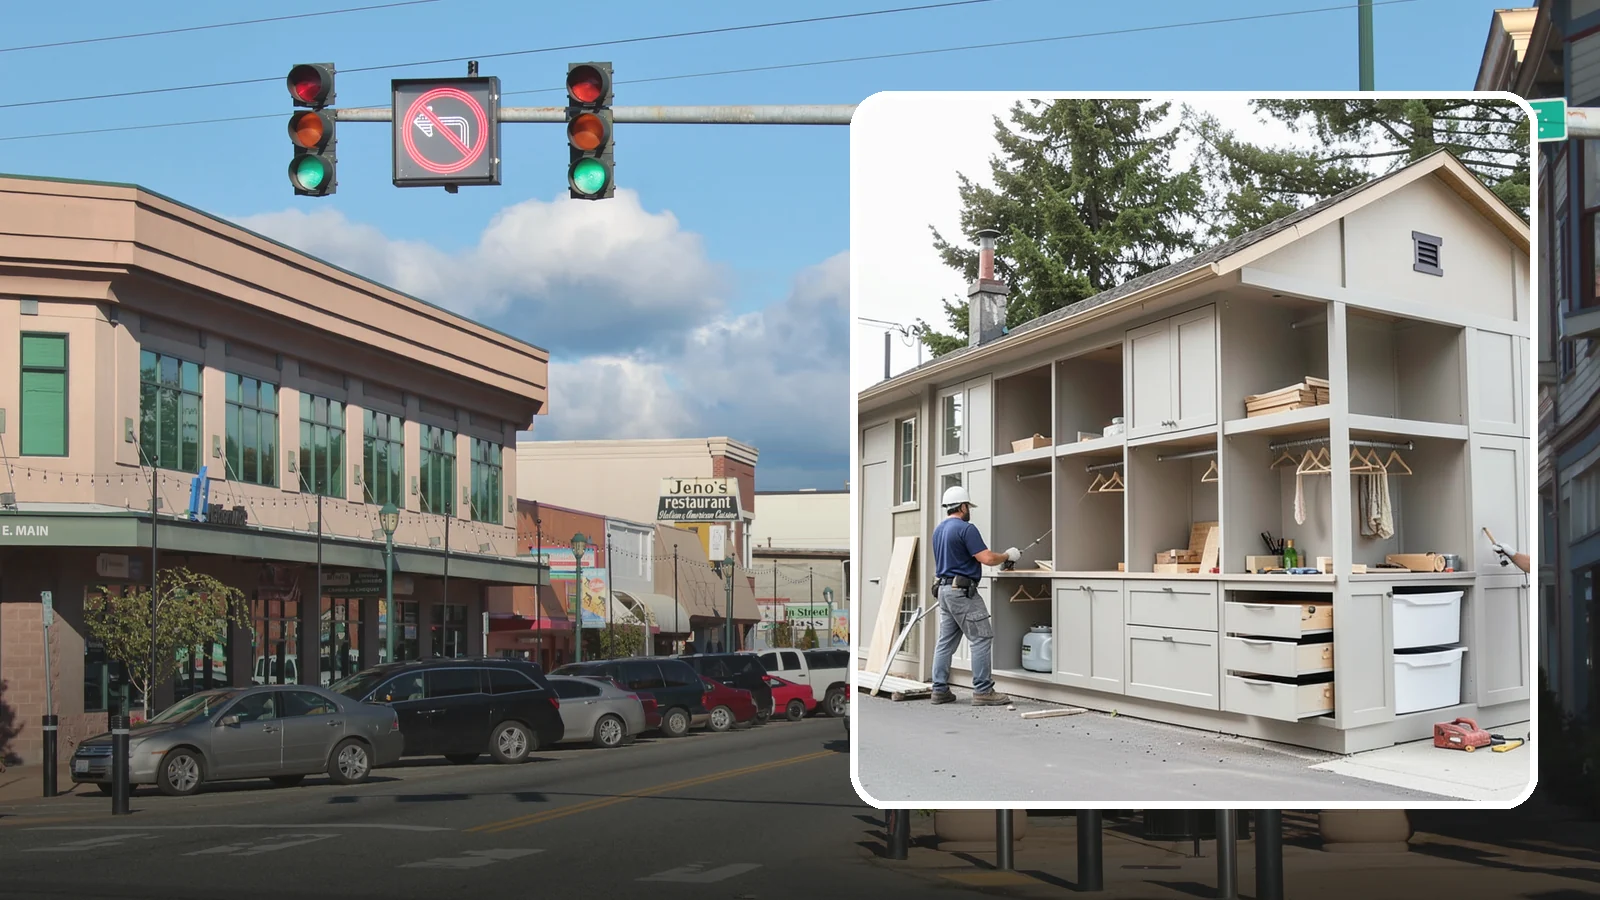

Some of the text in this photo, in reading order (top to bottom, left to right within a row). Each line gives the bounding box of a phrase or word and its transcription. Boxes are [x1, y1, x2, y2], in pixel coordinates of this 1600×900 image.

[669, 480, 728, 495] Jeno's
[665, 496, 731, 509] restaurant
[686, 509, 715, 520] American
[715, 509, 738, 520] Cuisine
[2, 525, 49, 536] E. MAIN
[797, 607, 829, 617] Street
